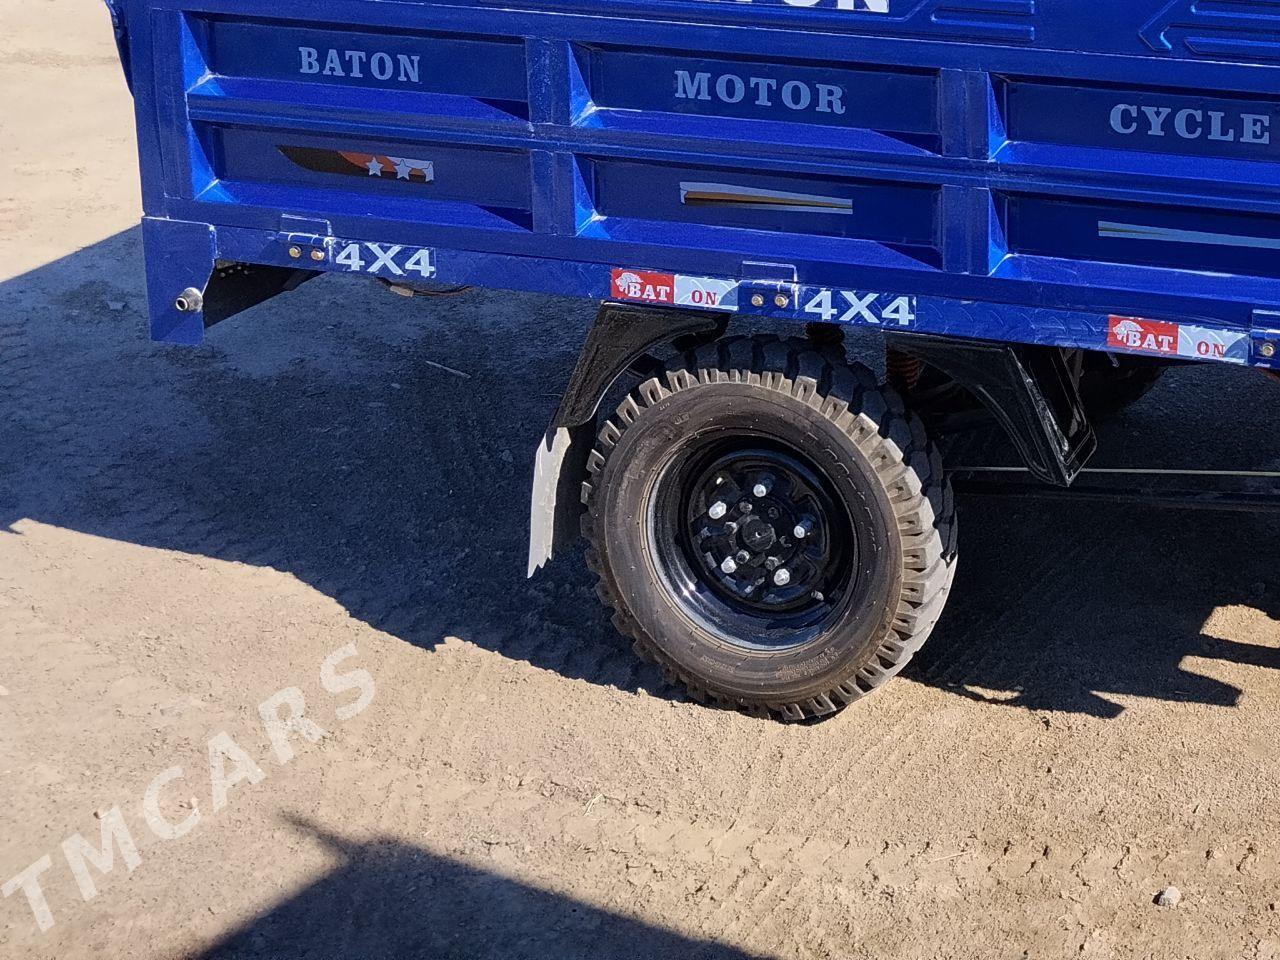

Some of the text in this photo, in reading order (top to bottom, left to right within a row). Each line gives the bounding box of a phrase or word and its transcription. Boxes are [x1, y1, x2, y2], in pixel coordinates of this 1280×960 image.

[300, 47, 1270, 145] BATON MOTOR CYCLE
[335, 243, 435, 278] 4X4
[804, 290, 915, 326] 4X4
